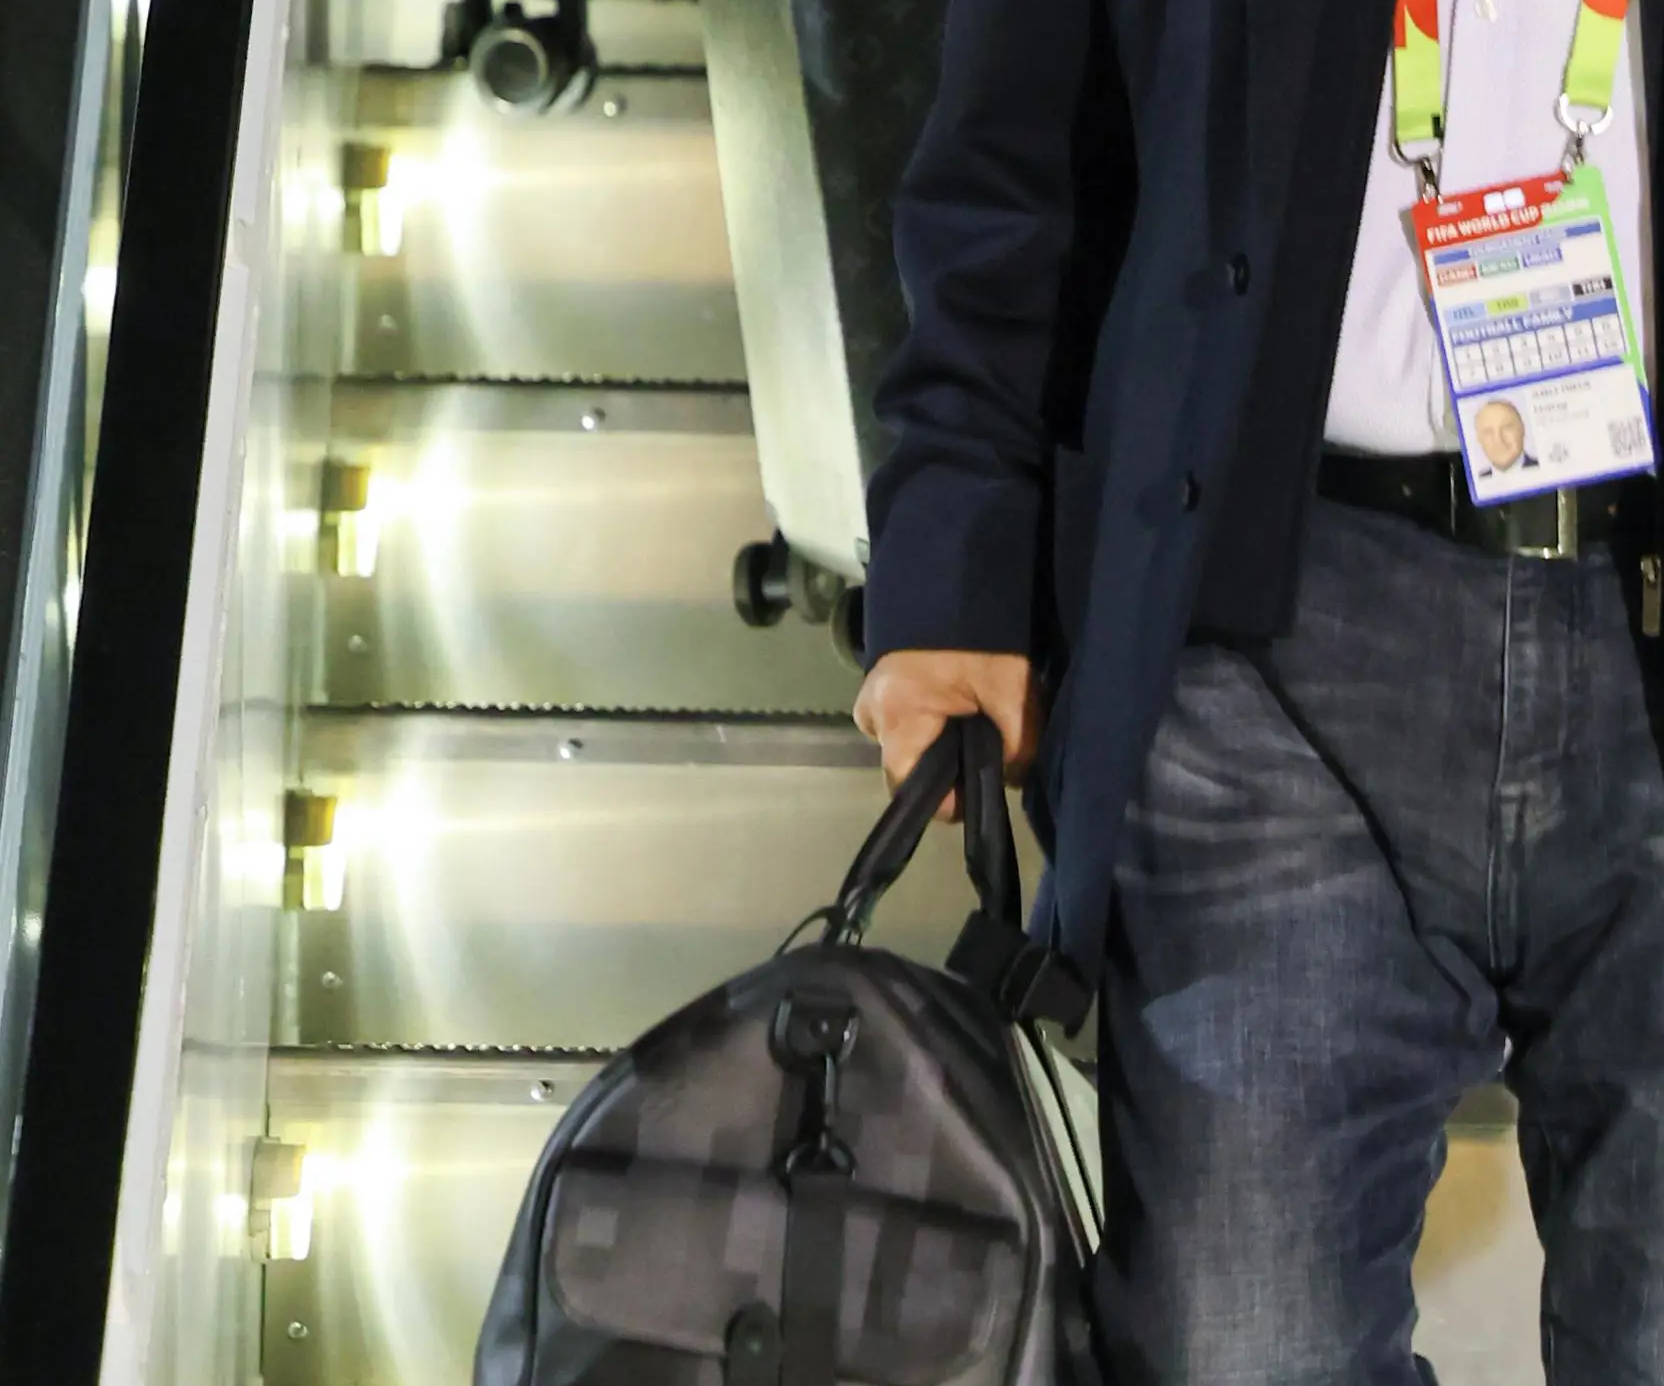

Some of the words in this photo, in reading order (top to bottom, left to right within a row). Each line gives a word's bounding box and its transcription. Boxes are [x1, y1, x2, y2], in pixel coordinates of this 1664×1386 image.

[1426, 222, 1458, 245] FIFA
[1458, 211, 1511, 237] WORLD
[1511, 205, 1541, 226] CUP
